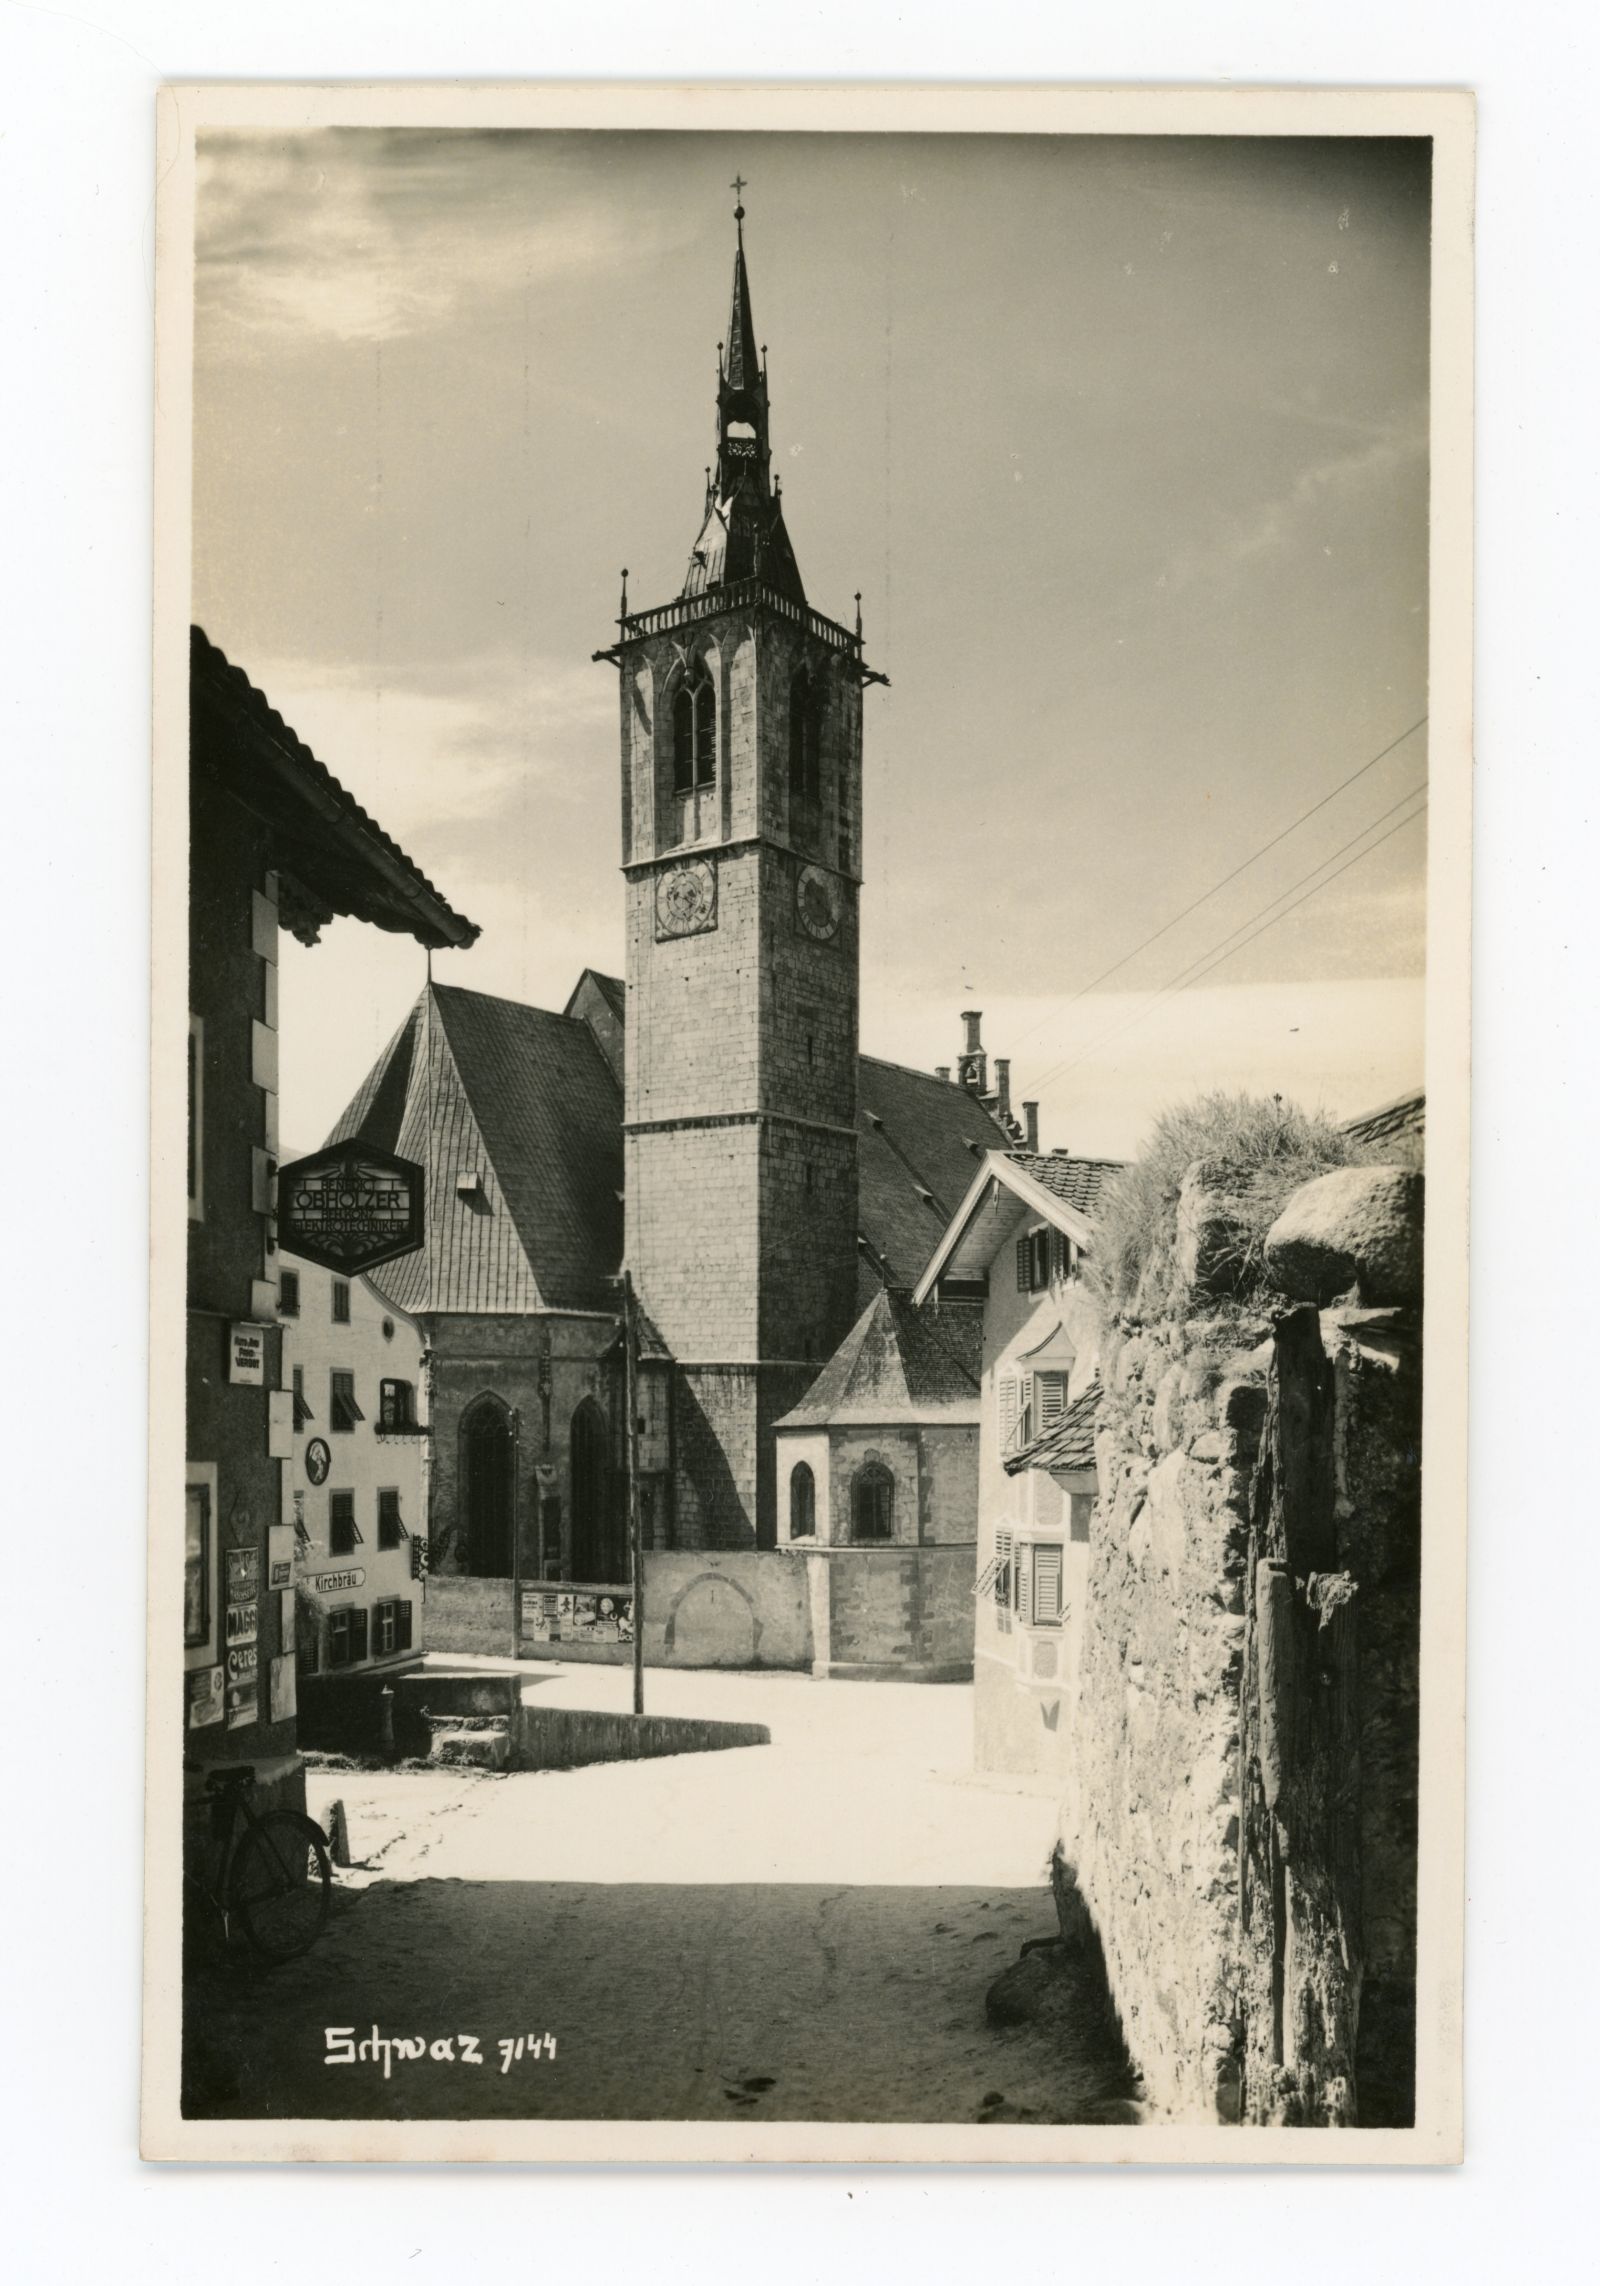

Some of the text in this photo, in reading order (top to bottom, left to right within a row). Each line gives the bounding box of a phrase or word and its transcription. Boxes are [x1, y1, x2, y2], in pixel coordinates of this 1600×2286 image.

[296, 1191, 401, 1209] OBHOLZER
[295, 1219, 405, 1232] ELEKTROTECHNIKER
[315, 1572, 357, 1591] Kirchbräu
[227, 1609, 258, 1639] MAGGI
[228, 1648, 258, 1680] Ceres
